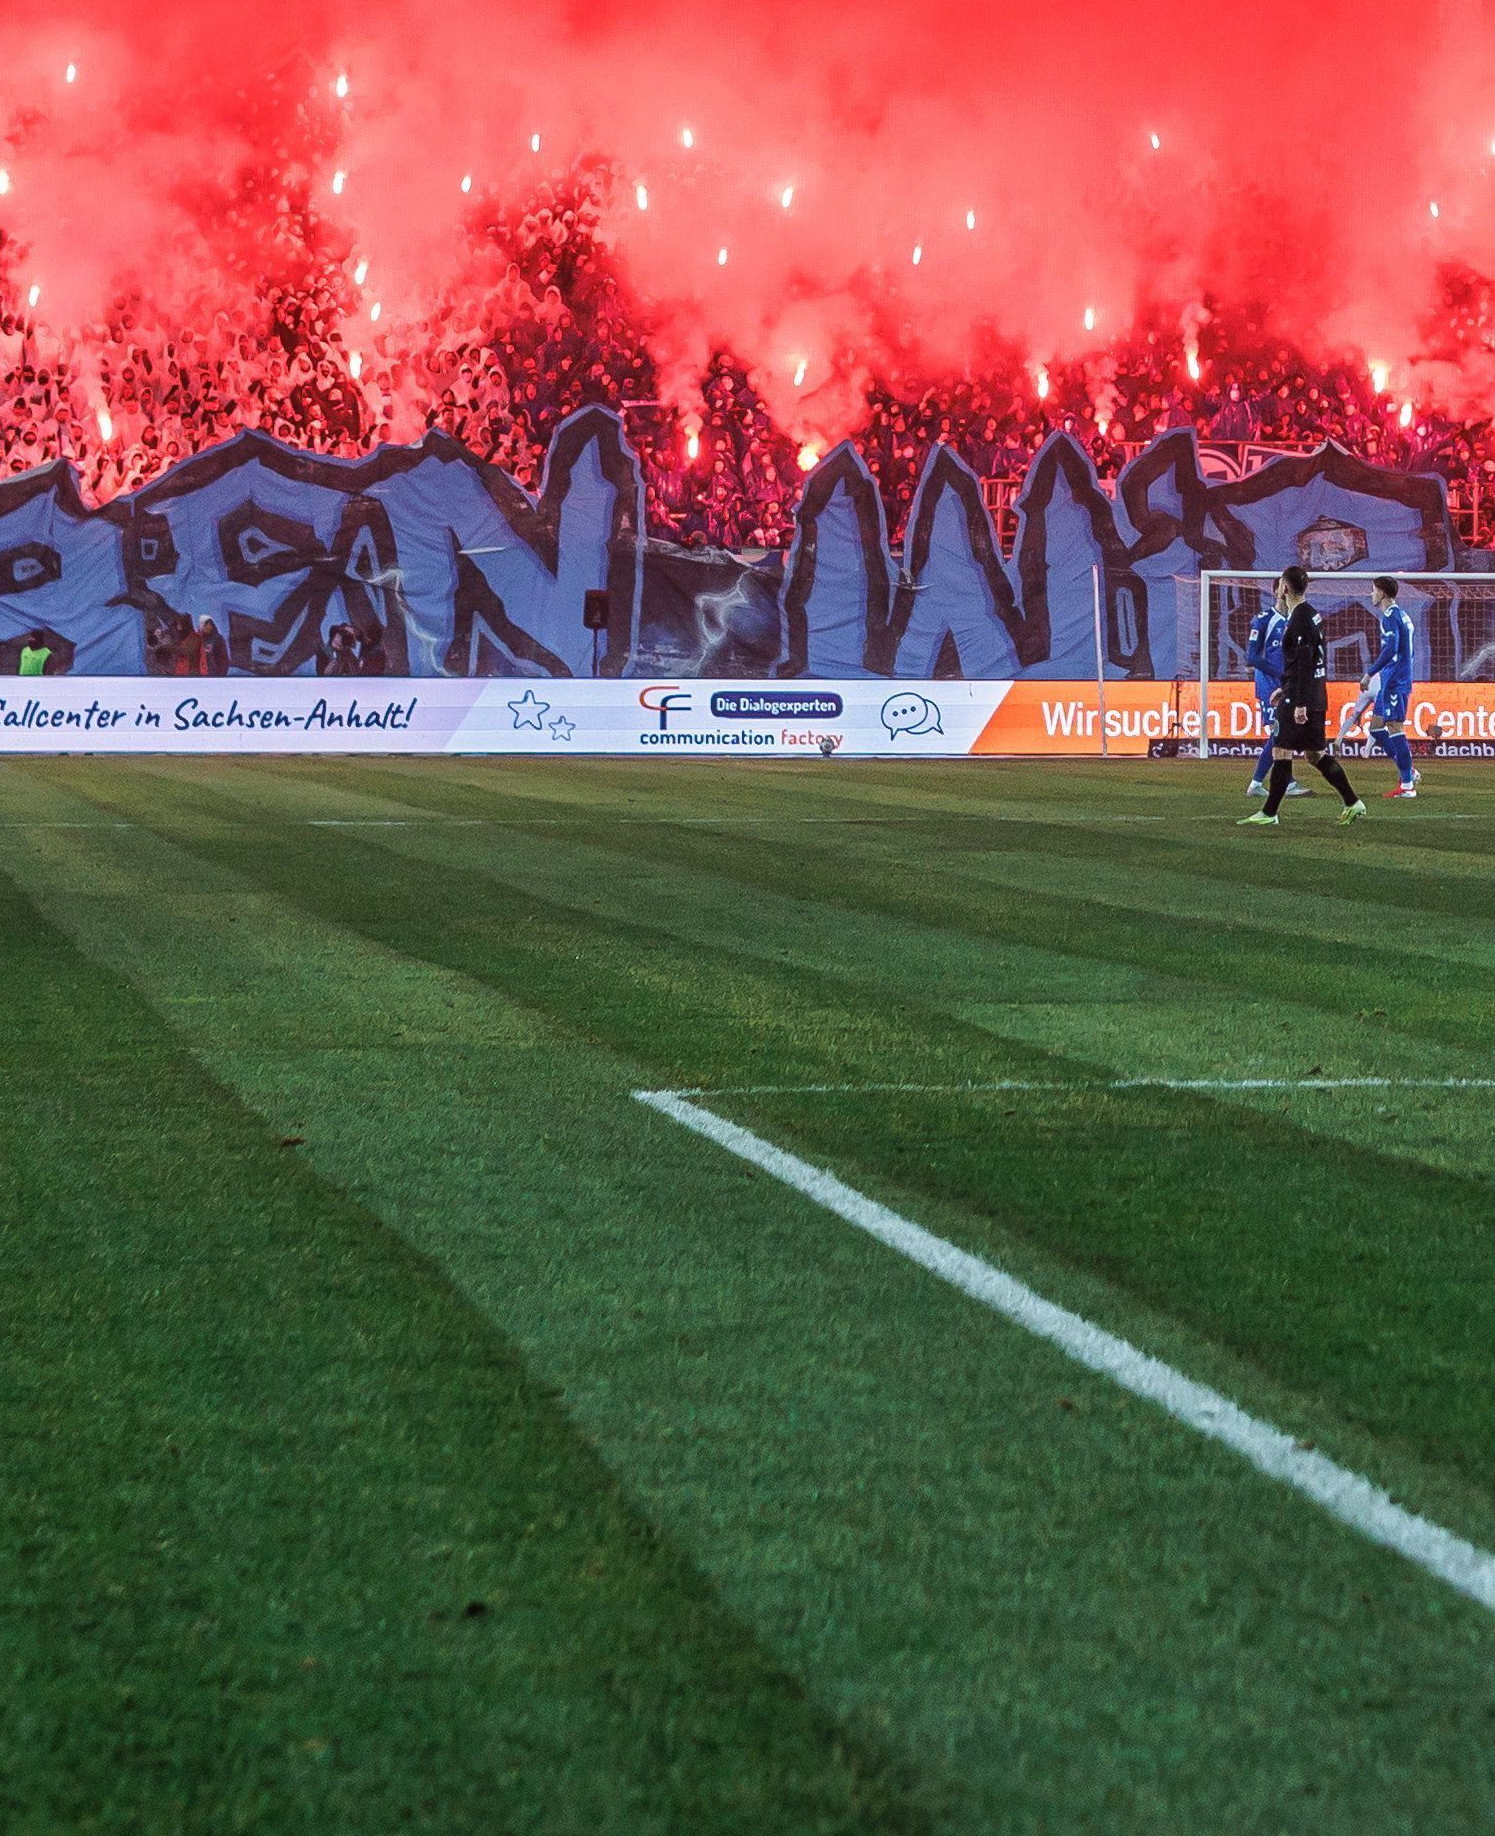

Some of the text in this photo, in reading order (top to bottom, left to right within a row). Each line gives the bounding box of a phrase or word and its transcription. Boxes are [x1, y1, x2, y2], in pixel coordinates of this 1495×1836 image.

[135, 702, 161, 729] in
[174, 696, 418, 732] Sachsen-Anhalt!
[716, 697, 837, 715] Die Dialogexperten
[1042, 701, 1099, 737] Wir
[1104, 701, 1221, 738] suchen
[639, 729, 775, 746] communication
